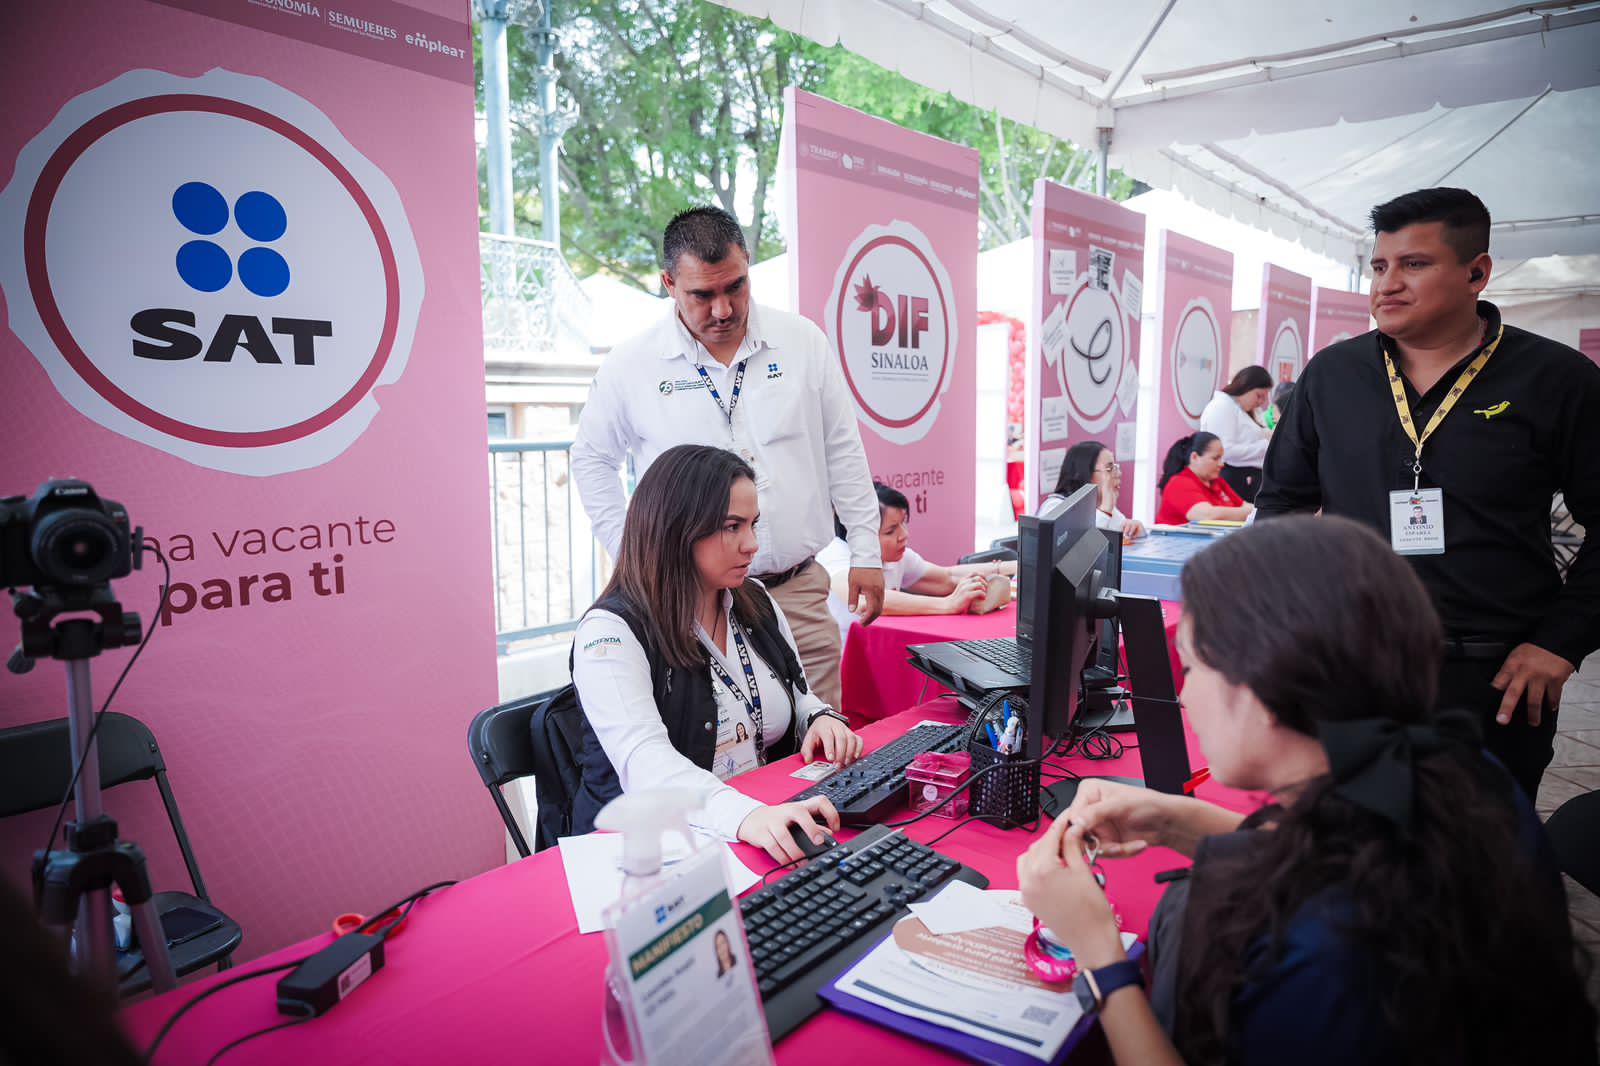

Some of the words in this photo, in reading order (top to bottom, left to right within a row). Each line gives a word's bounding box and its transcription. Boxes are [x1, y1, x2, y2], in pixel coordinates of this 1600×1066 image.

[328, 10, 397, 39] SEMUJERES
[131, 308, 332, 366] SAT
[871, 291, 928, 349] DIF
[871, 352, 928, 370] SINALOA
[887, 469, 944, 488] vacante
[915, 490, 928, 513] ti
[143, 533, 195, 563] na
[213, 516, 396, 558] vacante
[159, 572, 291, 626] para
[309, 554, 344, 596] ti
